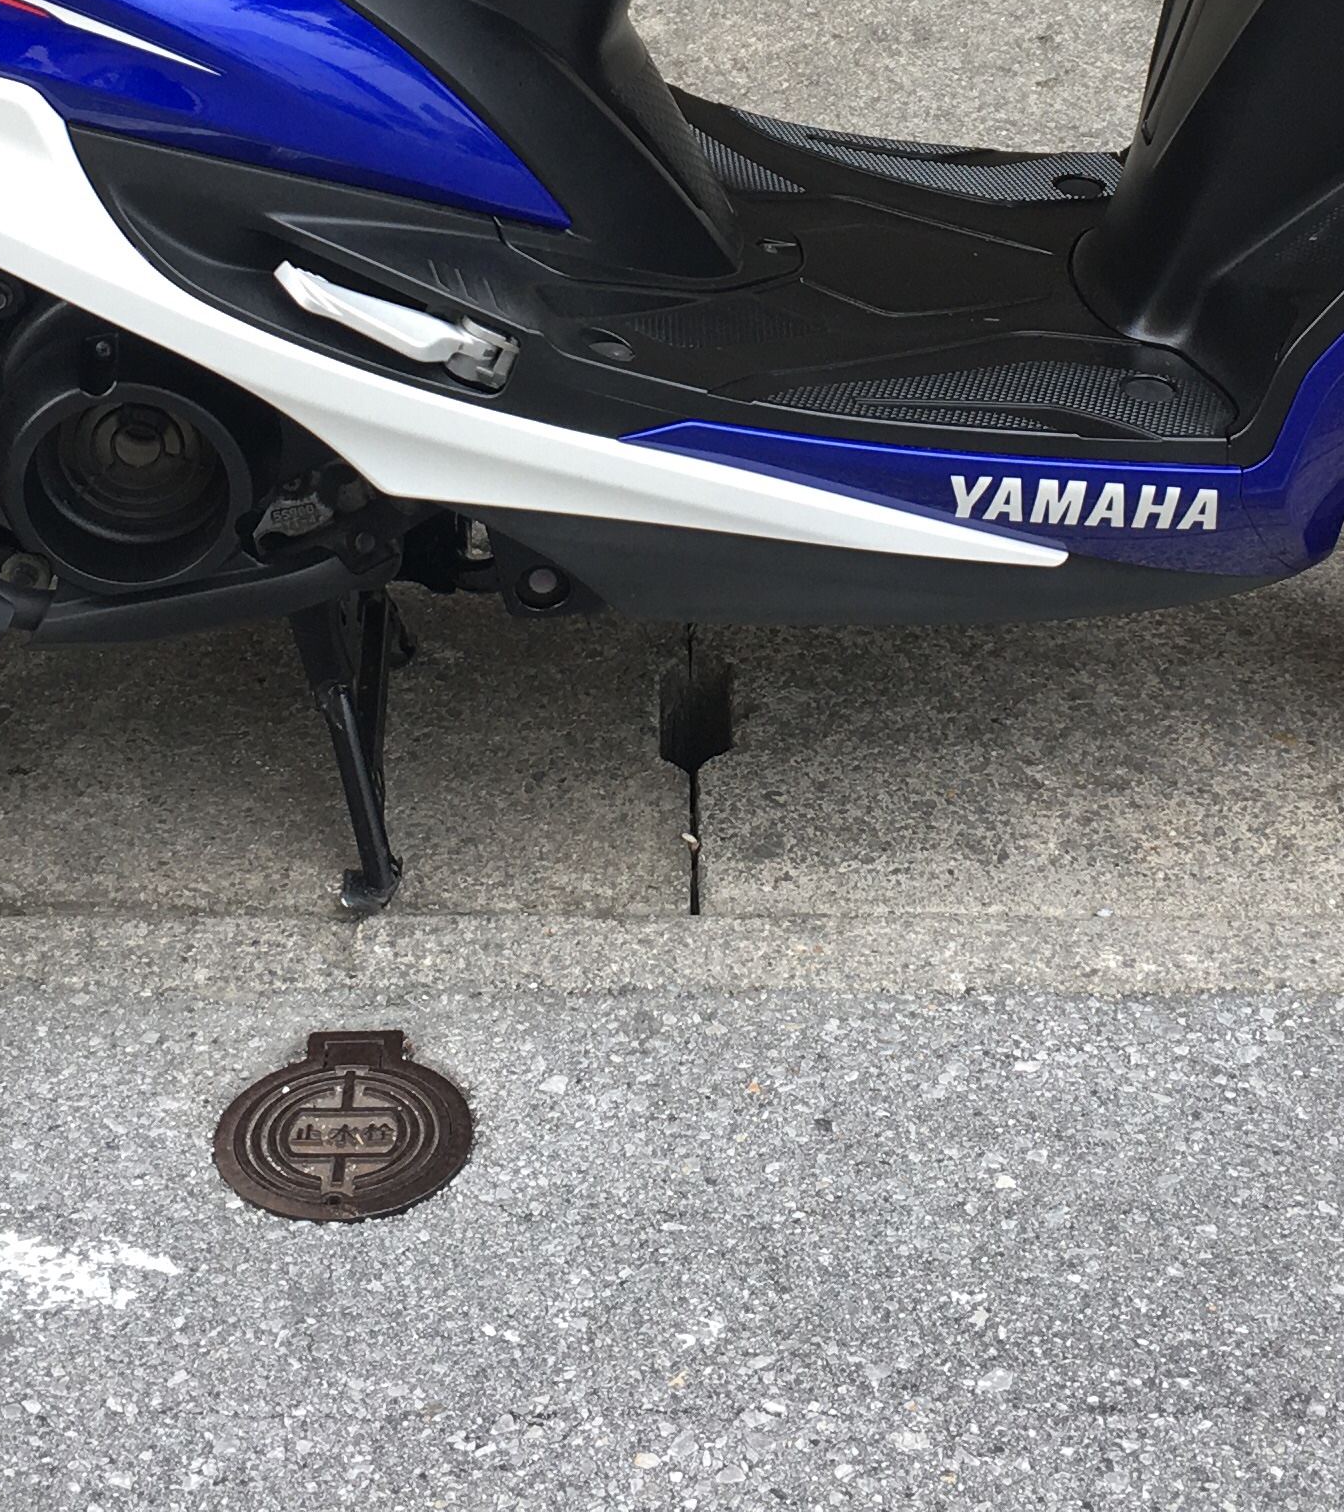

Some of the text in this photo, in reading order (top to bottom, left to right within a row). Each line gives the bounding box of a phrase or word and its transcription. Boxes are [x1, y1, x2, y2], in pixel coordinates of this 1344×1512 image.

[950, 474, 1219, 531] YAMAHA
[290, 1122, 396, 1149] 止水栓
